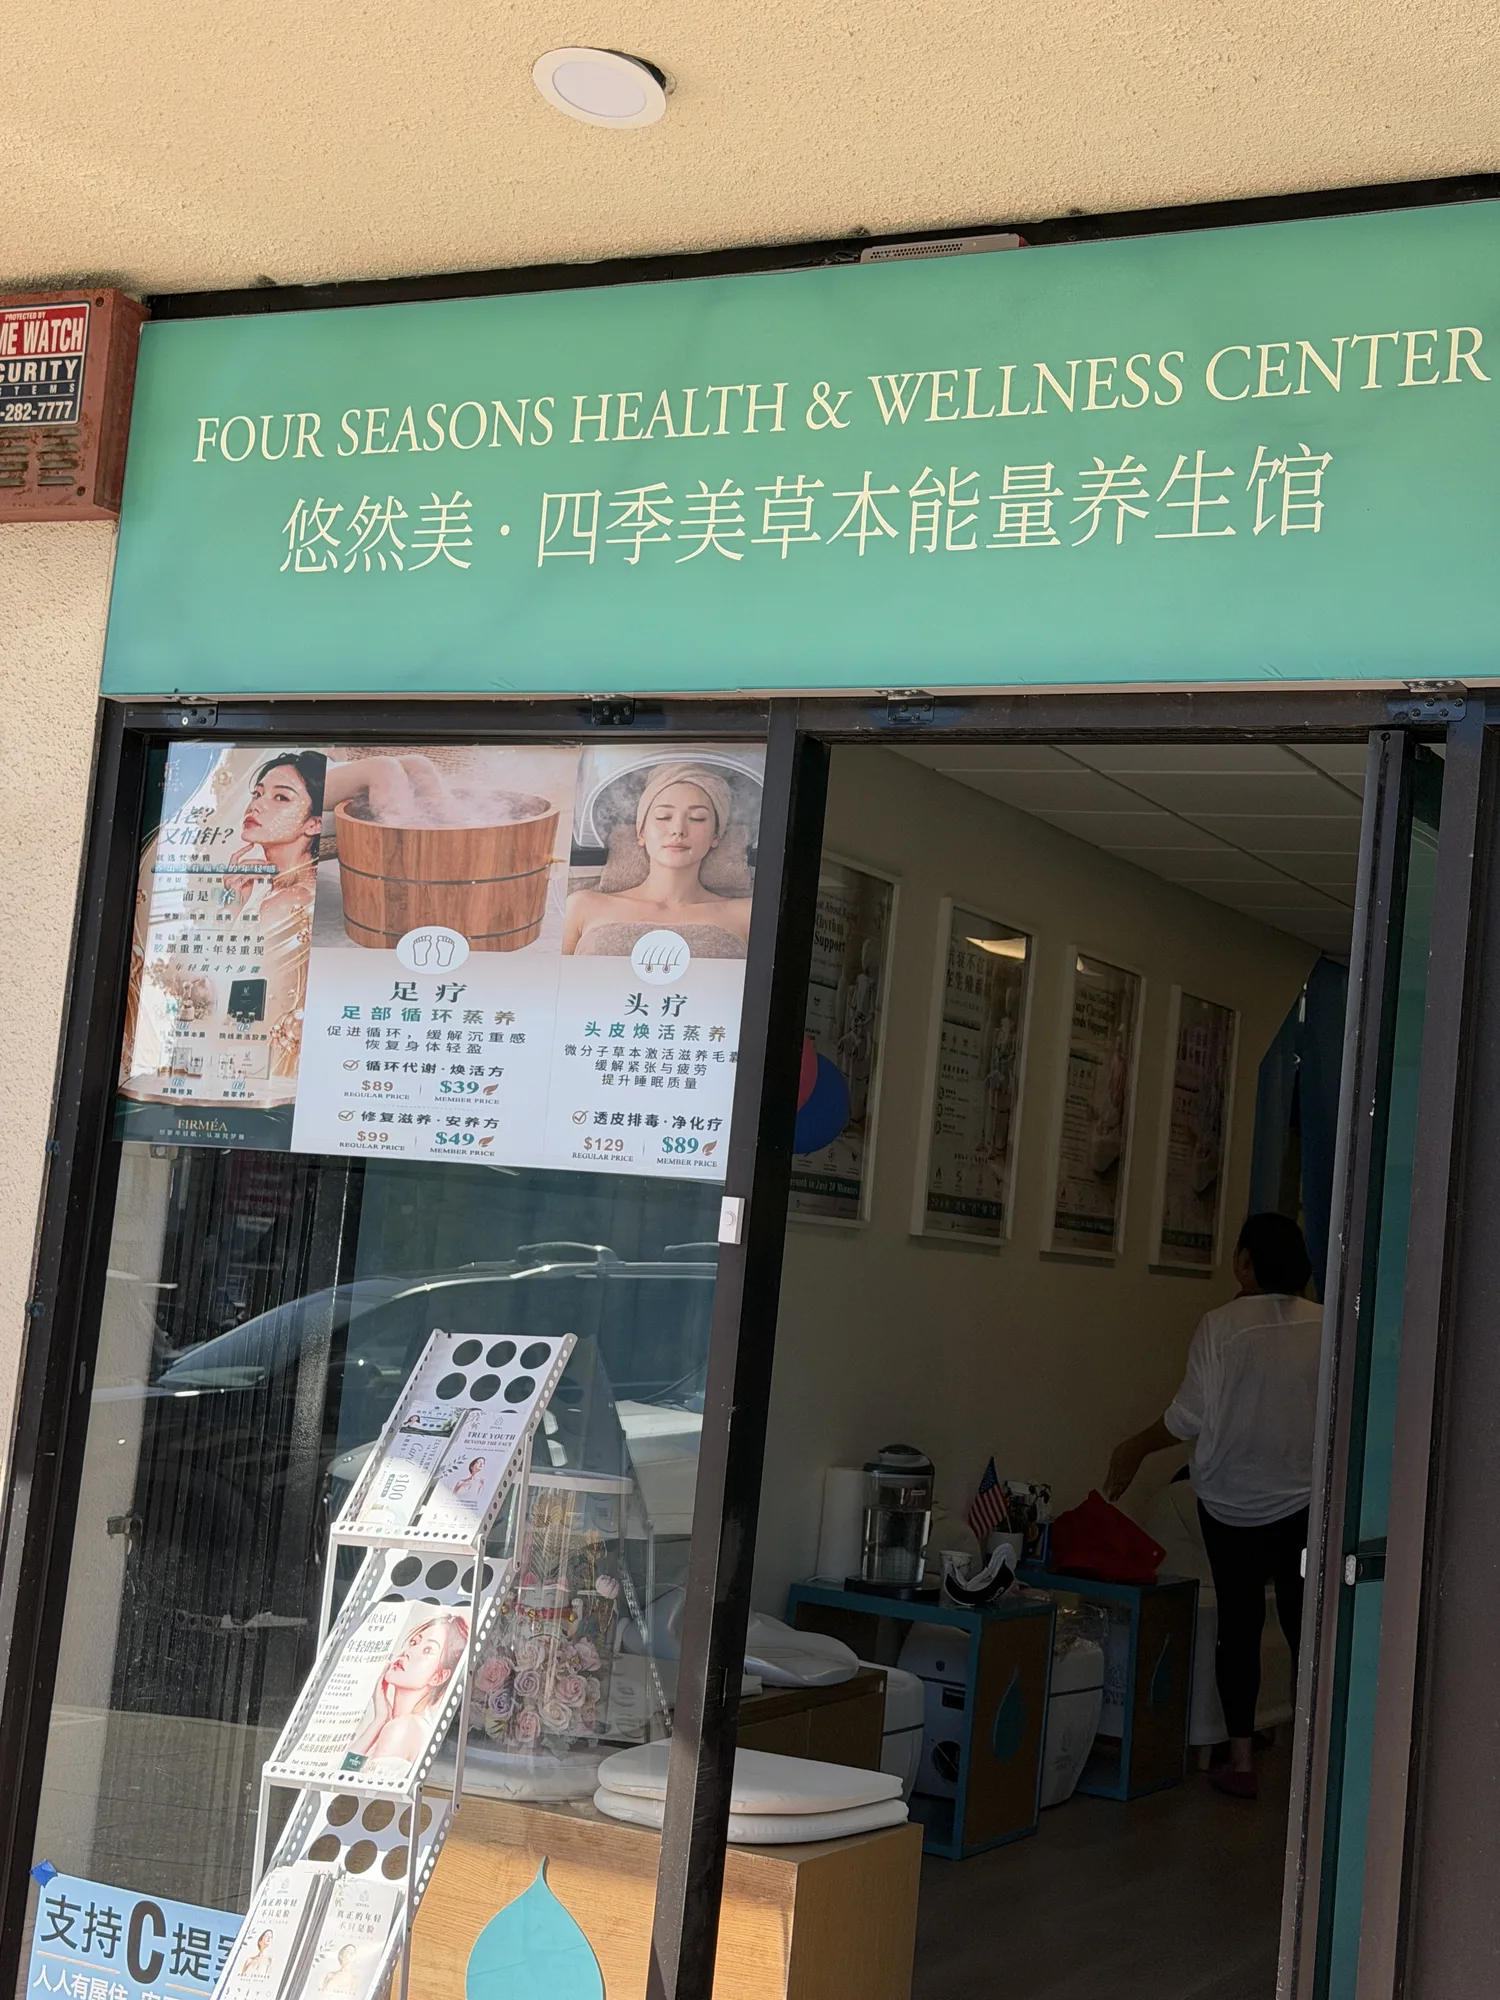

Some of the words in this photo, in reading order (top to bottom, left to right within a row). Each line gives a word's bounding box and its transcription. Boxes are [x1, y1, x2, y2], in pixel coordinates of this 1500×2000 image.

[4, 312, 37, 321] PROTECTED
[37, 311, 47, 319] BY
[23, 318, 84, 354] WATCH
[193, 412, 325, 463] FOUR
[335, 396, 555, 457] SEASONS
[568, 380, 789, 444] HEALTH
[804, 379, 854, 432] &
[867, 350, 1186, 427] WELLNESS
[1205, 326, 1492, 402] CENTER
[814, 930, 846, 953] Support
[389, 980, 468, 1004] 足疗
[623, 992, 689, 1018] 头疗
[341, 1005, 517, 1027] 足部循环蒸养
[584, 1020, 727, 1043] 头皮焕活蒸养
[364, 1038, 483, 1056] 恢复身体轻盈
[594, 1058, 708, 1076] 缓解紧张与疲劳
[361, 1079, 395, 1092] $89
[438, 1079, 481, 1095] $39
[601, 1073, 698, 1090] 提升睡眠质量
[343, 1091, 384, 1100] REGULAR
[384, 1092, 411, 1101] PRICE
[433, 1095, 473, 1104] MEMBER
[473, 1096, 500, 1105] PRICE
[176, 1117, 229, 1133] FIRMÉA
[356, 1130, 390, 1143] $99
[435, 1131, 476, 1147] $49
[583, 1136, 625, 1152] $129
[661, 1135, 700, 1154] $89
[338, 1141, 380, 1151] REGULAR
[380, 1143, 406, 1152] PRICE
[429, 1147, 469, 1156] MEMBER
[469, 1148, 496, 1157] PRICE
[571, 1151, 609, 1161] REGULAR
[610, 1153, 634, 1163] PRICE
[656, 1157, 693, 1167] MEMBER
[694, 1159, 718, 1168] PRICE
[467, 1431, 488, 1439] TRUE
[489, 1433, 517, 1441] YOUTH
[388, 1473, 410, 1500] $100
[365, 1611, 397, 1624] IRMÉA
